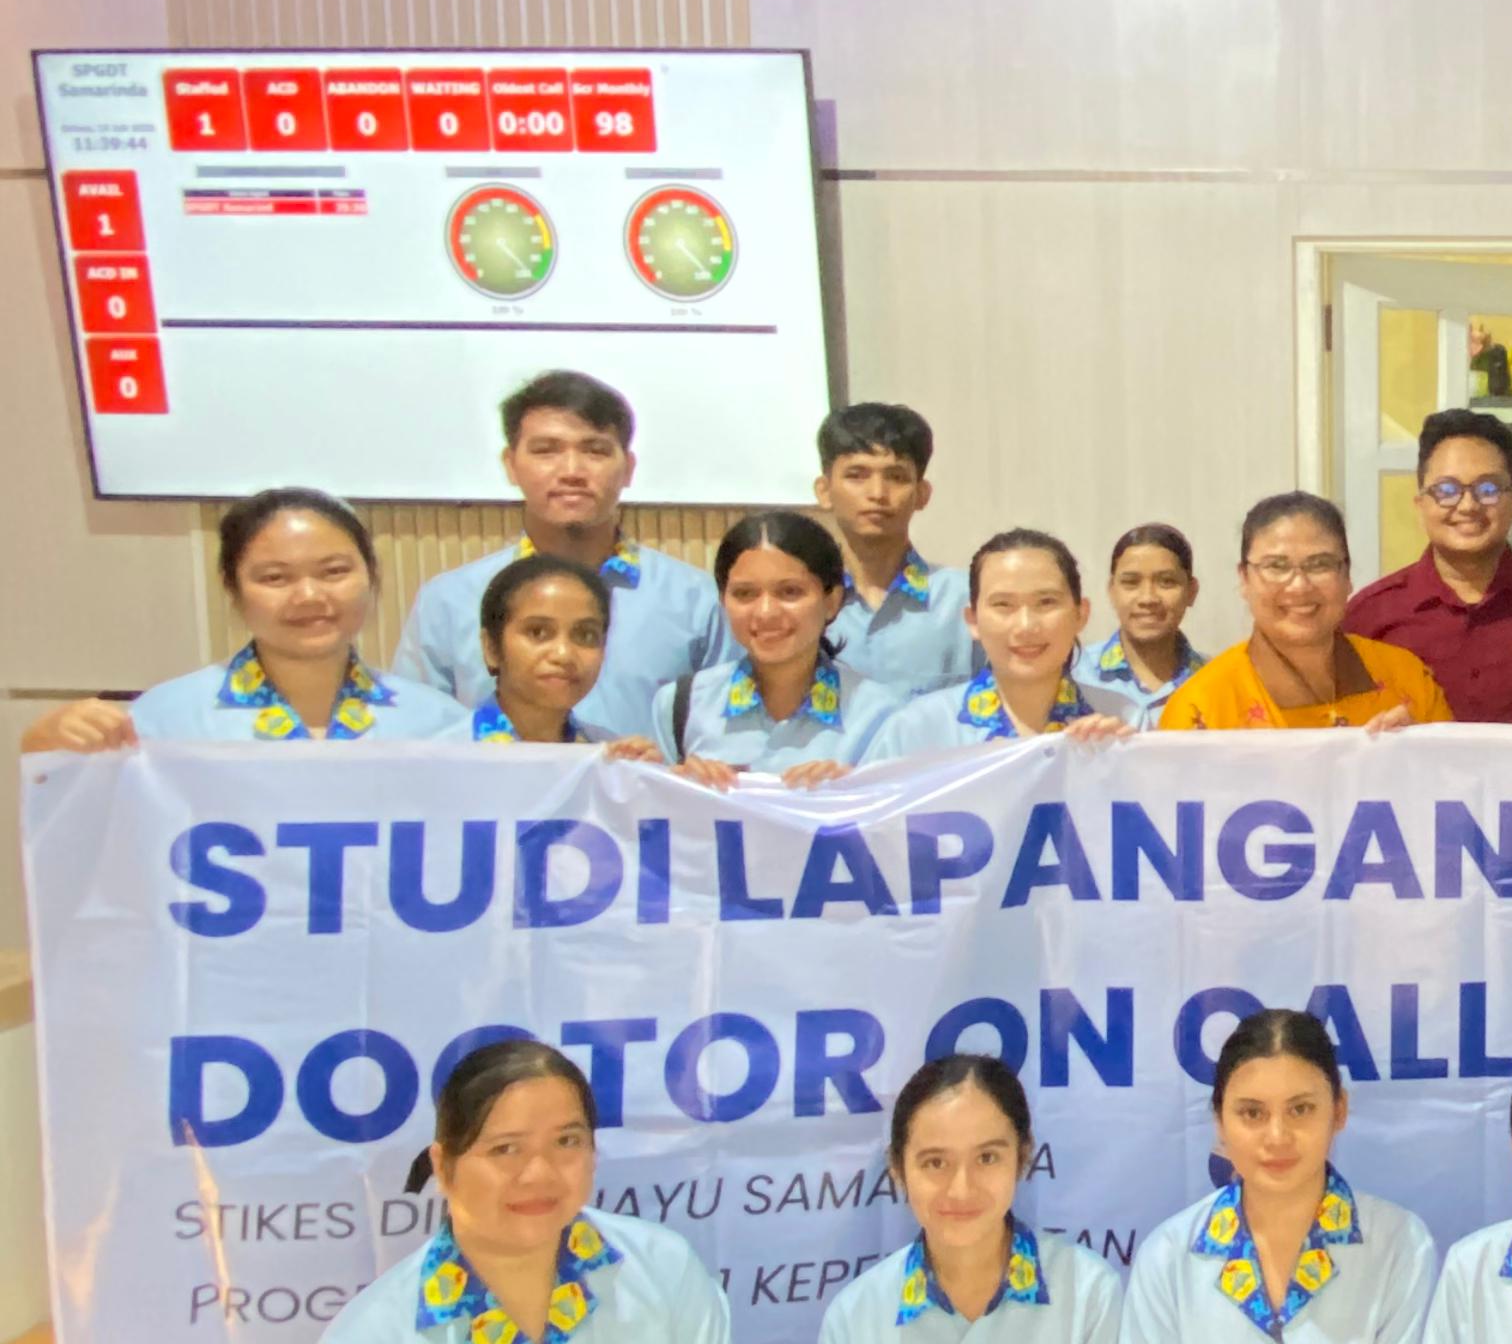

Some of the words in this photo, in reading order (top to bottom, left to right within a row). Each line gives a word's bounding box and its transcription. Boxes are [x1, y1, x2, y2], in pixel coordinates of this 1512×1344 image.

[266, 81, 299, 95] ACD
[198, 112, 217, 137] 1
[275, 111, 297, 137] 0
[356, 111, 378, 137] 0
[438, 111, 460, 137] 0
[498, 111, 565, 137] 0:00
[594, 111, 635, 137] 98
[96, 213, 116, 237] 1
[106, 295, 128, 320] 0
[118, 375, 139, 400] 0
[168, 817, 671, 938] STUDI
[924, 987, 1134, 1087] ON
[175, 1200, 356, 1242] STIKES
